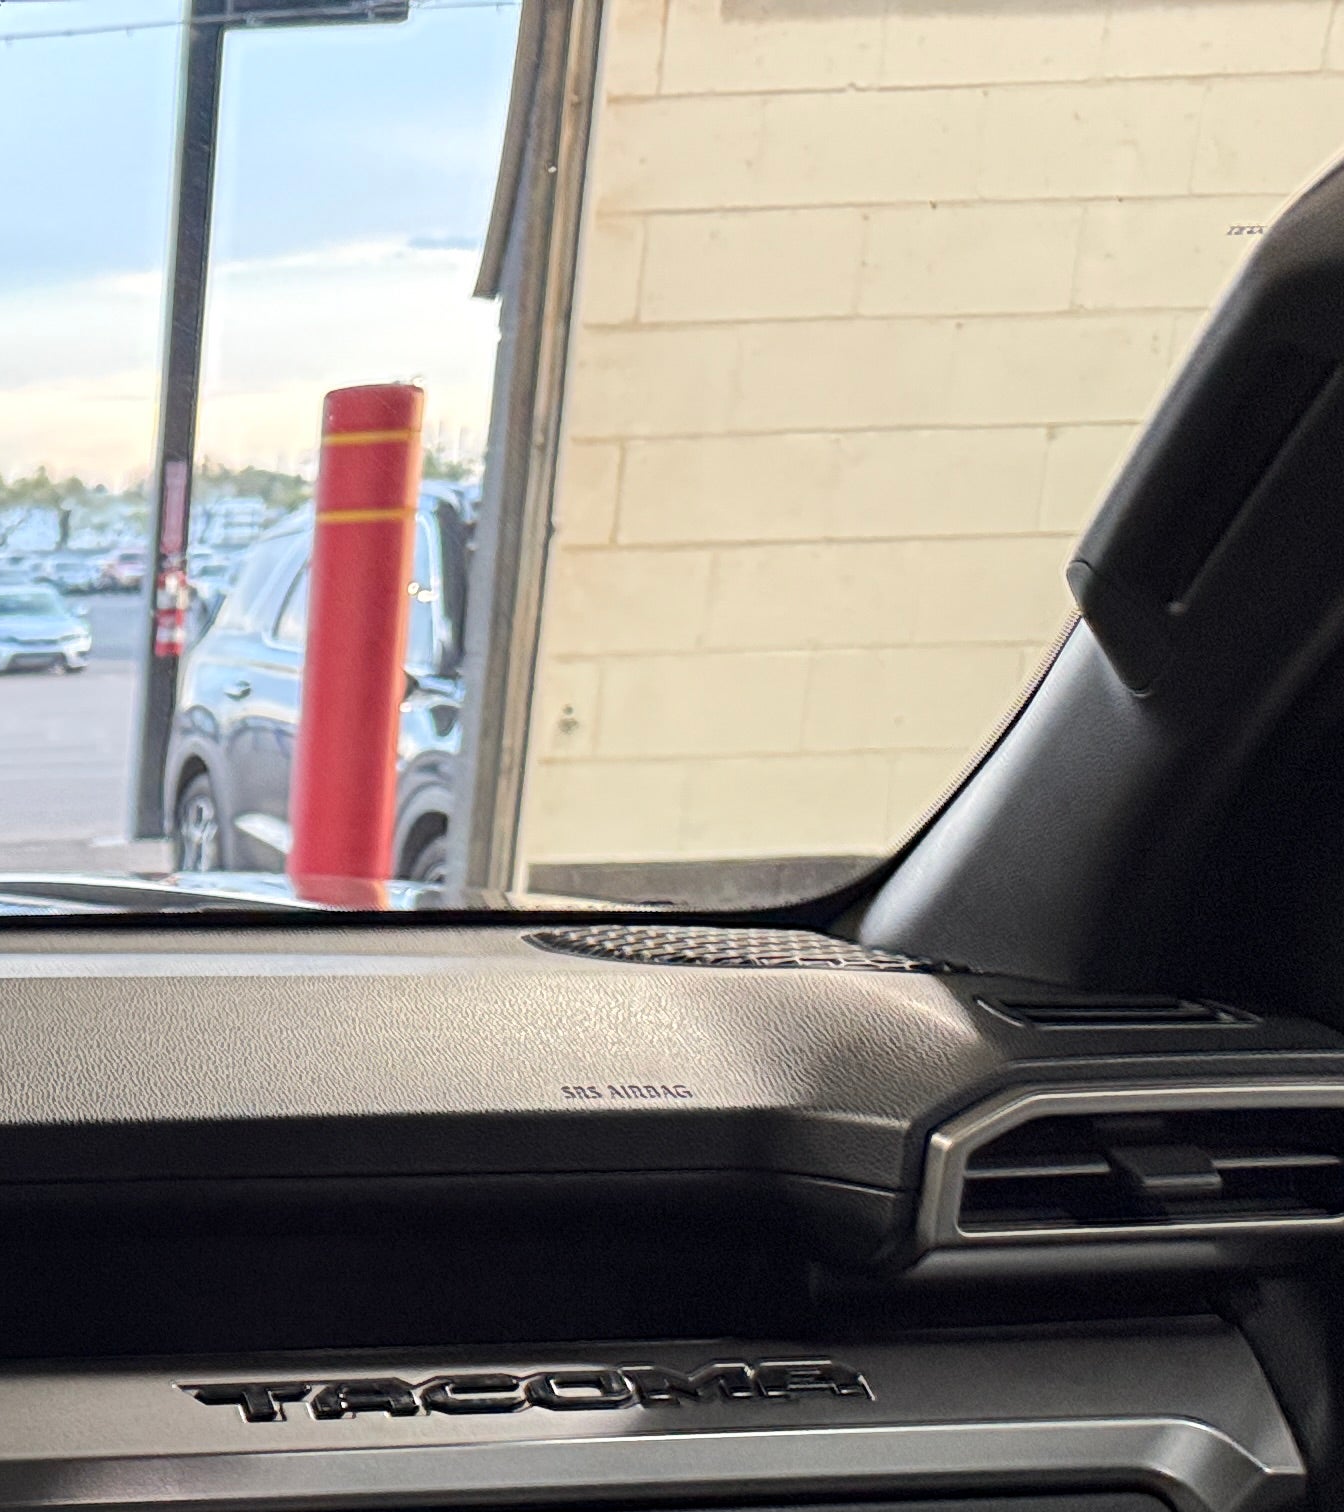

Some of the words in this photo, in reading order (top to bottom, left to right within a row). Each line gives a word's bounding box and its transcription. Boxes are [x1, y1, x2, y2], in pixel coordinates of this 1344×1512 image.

[561, 1085, 602, 1099] SRS
[607, 1084, 693, 1099] AIRBAG
[172, 1360, 875, 1423] TACOMA
